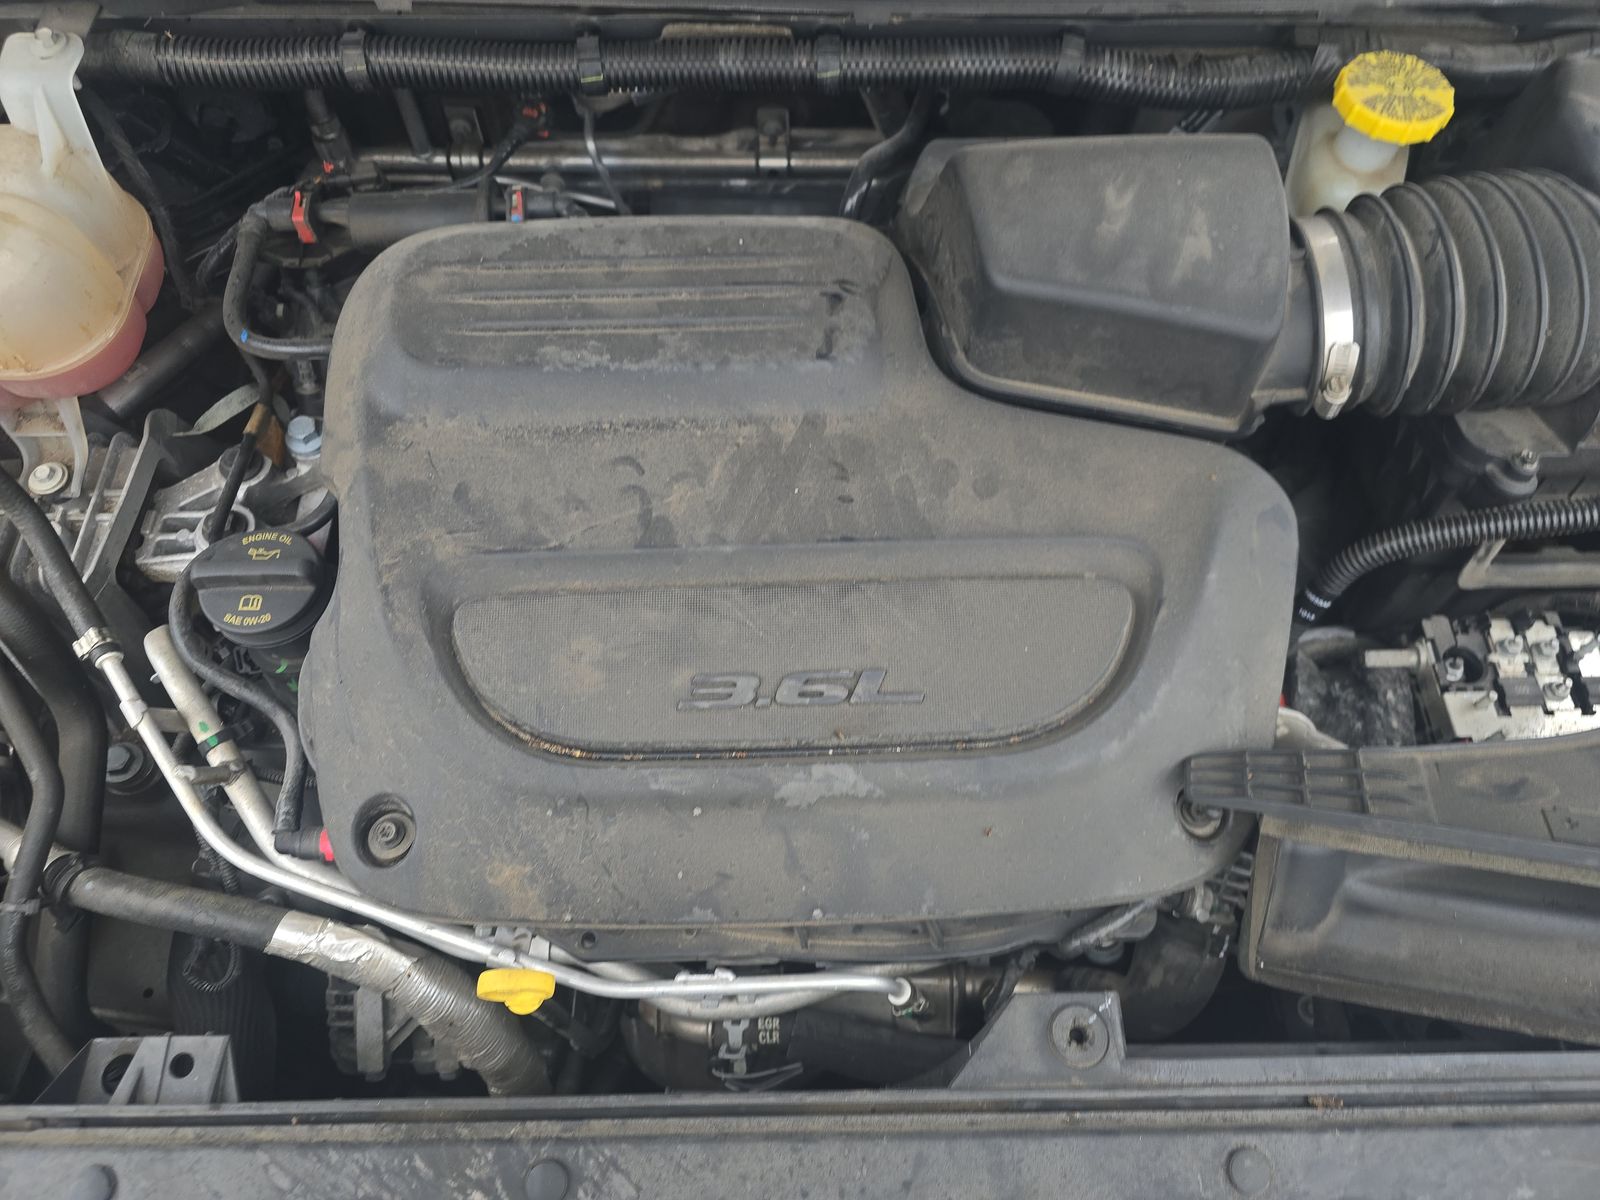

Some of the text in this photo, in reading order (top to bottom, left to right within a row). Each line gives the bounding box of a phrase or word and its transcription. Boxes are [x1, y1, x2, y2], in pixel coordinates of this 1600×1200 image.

[242, 532, 293, 545] ENGINE OIL
[223, 613, 272, 626] SAE 0W-20
[676, 669, 926, 711] 3.6L
[758, 1031, 780, 1044] CLR
